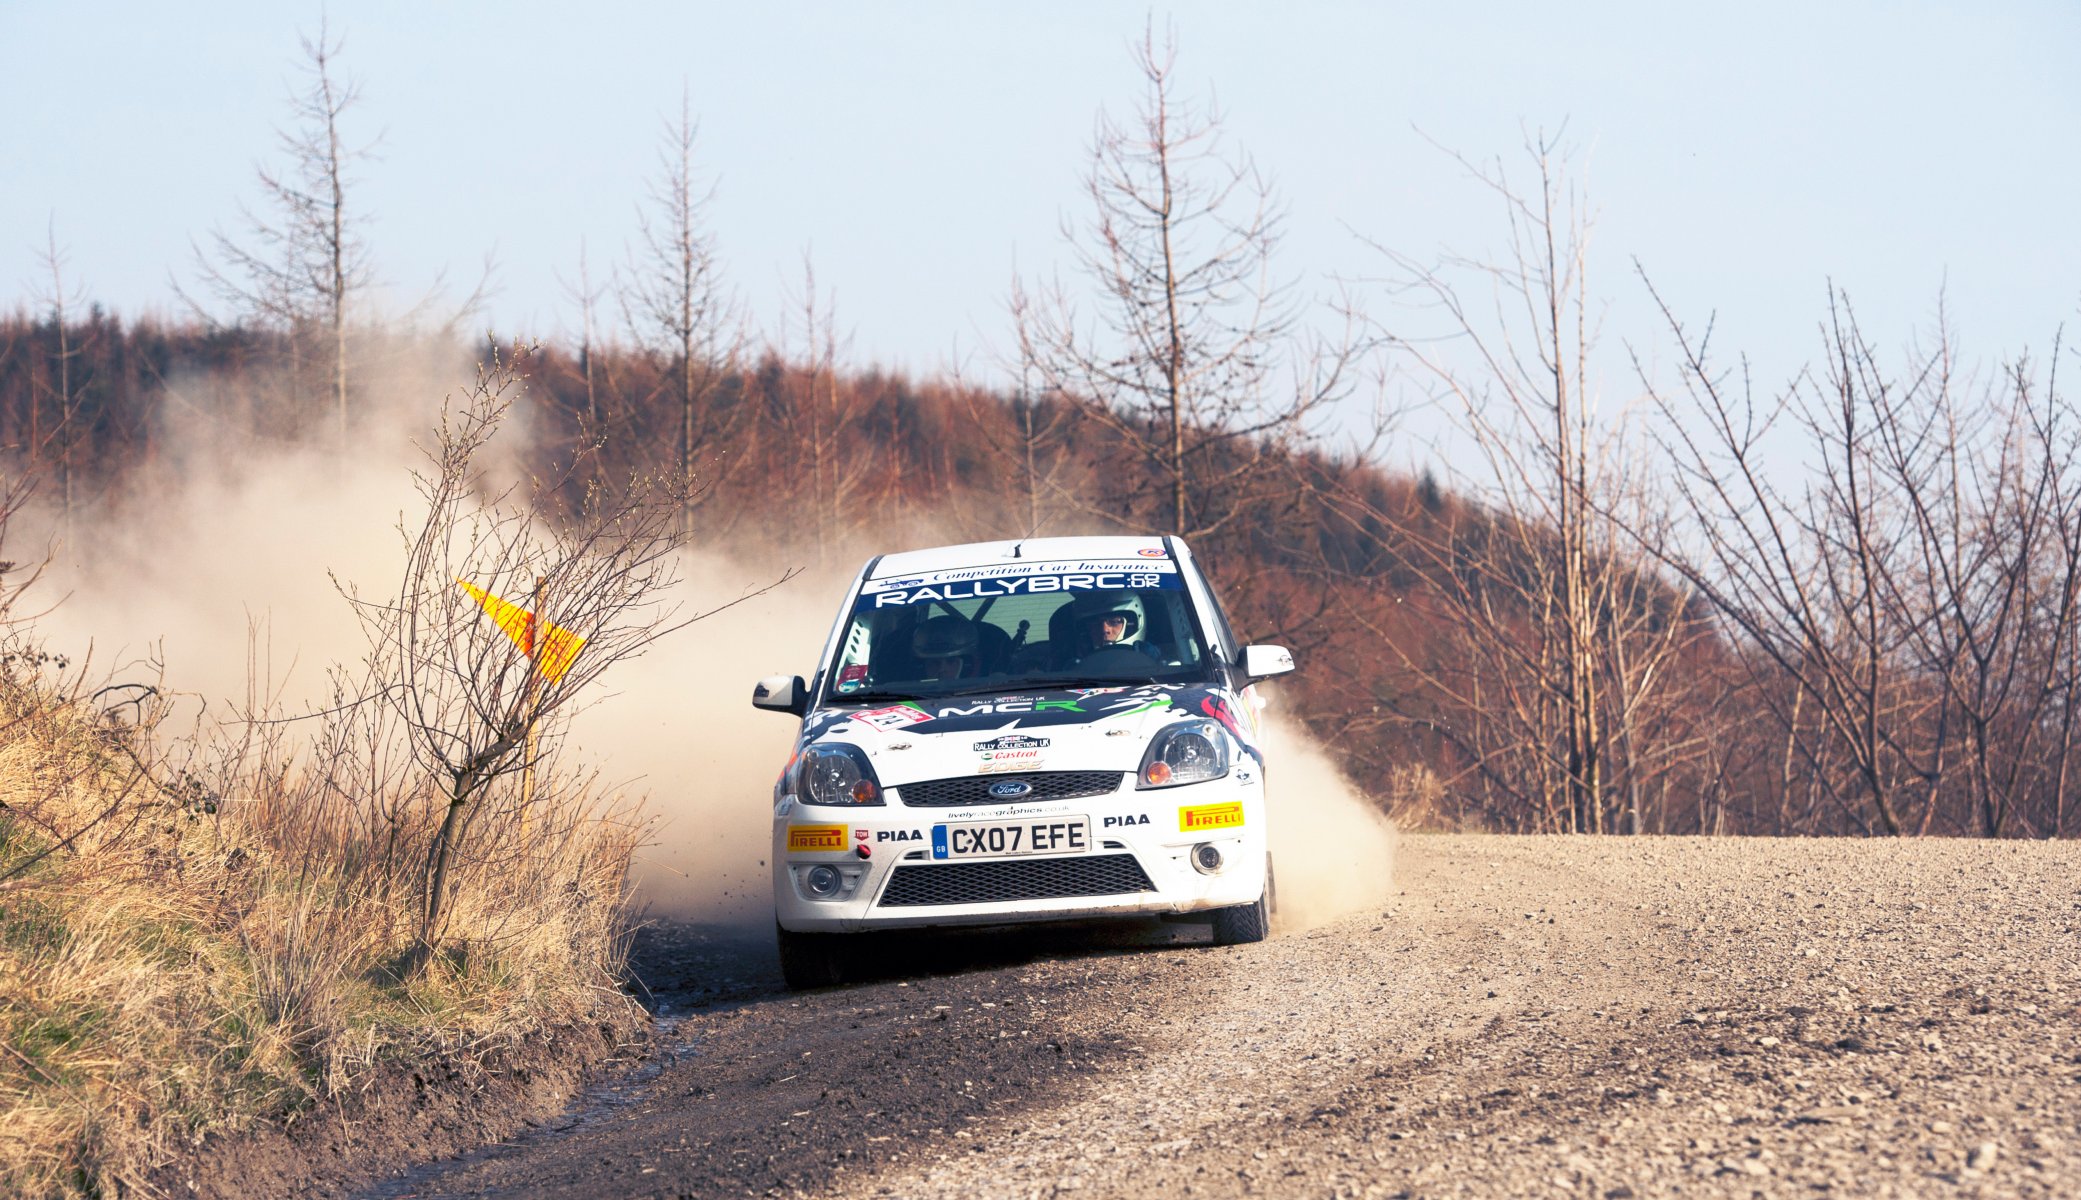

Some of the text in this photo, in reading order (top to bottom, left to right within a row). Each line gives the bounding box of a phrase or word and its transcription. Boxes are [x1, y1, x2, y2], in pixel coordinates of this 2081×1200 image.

[933, 562, 1164, 581] Competition Car Insurance
[938, 700, 1087, 718] MCR
[974, 743, 995, 751] RALLY
[1040, 739, 1050, 747] UK
[995, 750, 1037, 759] Castrol
[978, 760, 1045, 773] EDGE
[997, 784, 1022, 794] Ford
[1103, 814, 1150, 828] PIAA
[1186, 806, 1239, 827] PIRELLI
[790, 829, 842, 847] PIRELLI
[877, 829, 923, 842] PIAA
[952, 823, 1085, 854] CX07 EFE
[936, 845, 946, 853] GB
